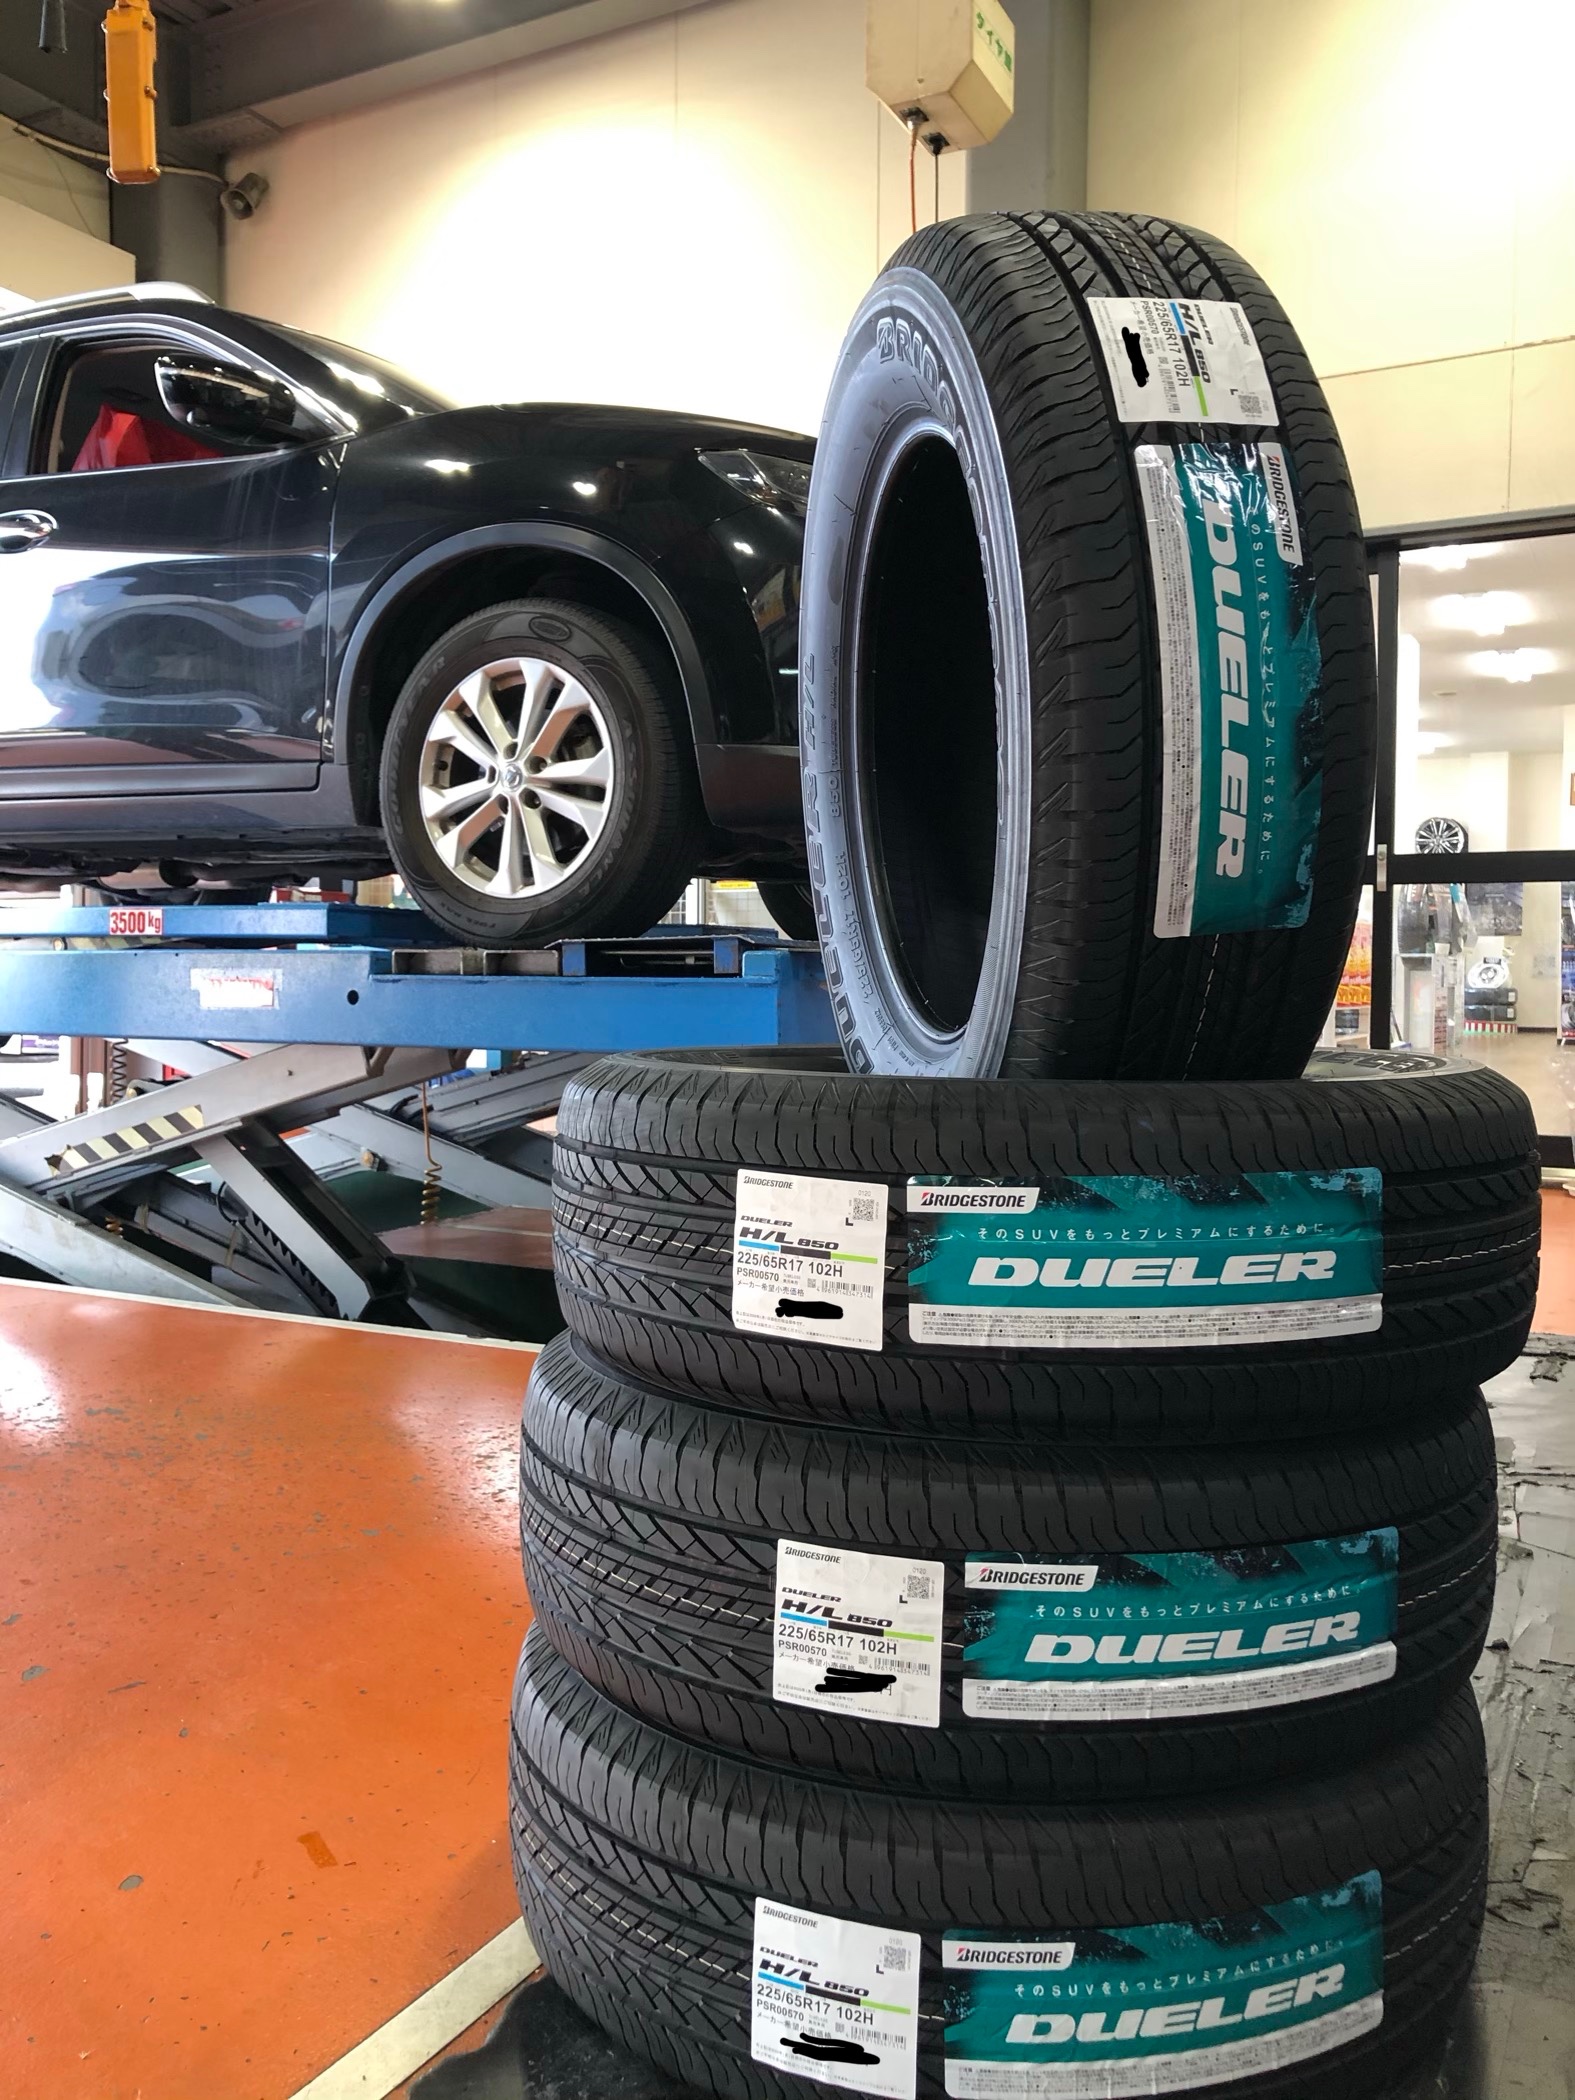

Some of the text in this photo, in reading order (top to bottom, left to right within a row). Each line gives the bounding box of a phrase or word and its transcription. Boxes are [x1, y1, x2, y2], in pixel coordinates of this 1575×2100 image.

[1140, 300, 1160, 335] PSR00570
[1193, 304, 1214, 345] DUELER
[1153, 301, 1182, 354] 225/65R17
[1172, 358, 1191, 387] 102H
[1178, 303, 1212, 384] H/L 850
[1266, 455, 1295, 553] BRIDGESTONE
[1201, 498, 1249, 878] DUELER
[829, 776, 841, 817] 850
[110, 911, 161, 934] 3500 kg
[743, 1175, 794, 1190] BRIDGESTONE
[921, 1191, 1027, 1209] BRIDGESTONE
[740, 1215, 794, 1228] DUELER
[845, 1217, 854, 1226] L
[739, 1226, 840, 1251] H/L 850
[736, 1266, 780, 1282] PSR00570
[737, 1251, 843, 1278] 225/65R17 102H
[968, 1251, 1336, 1287] DUELER
[736, 1279, 805, 1298] メーカー希望小売価格
[784, 1546, 842, 1564] BRIDGESTONE
[978, 1567, 1085, 1587] BRIDGESTONE
[781, 1586, 842, 1603] DUELER
[898, 1594, 908, 1604] L
[781, 1598, 893, 1627] H/L 850
[778, 1623, 897, 1655] 225/65R17 102H
[778, 1639, 828, 1657] PSR00570
[1024, 1611, 1361, 1664] DUELER
[762, 1905, 818, 1929] BRIDGESTONE
[759, 1946, 819, 1968] DUELER
[956, 1946, 1062, 1965] BRIDGESTONE
[759, 1958, 870, 1997] H/L 850
[875, 1964, 885, 1975] L
[756, 1998, 805, 2022] PSR00570
[757, 1983, 831, 2015] 225/65R17
[836, 2007, 874, 2026] 102H
[1005, 1963, 1345, 2044] DUELER
